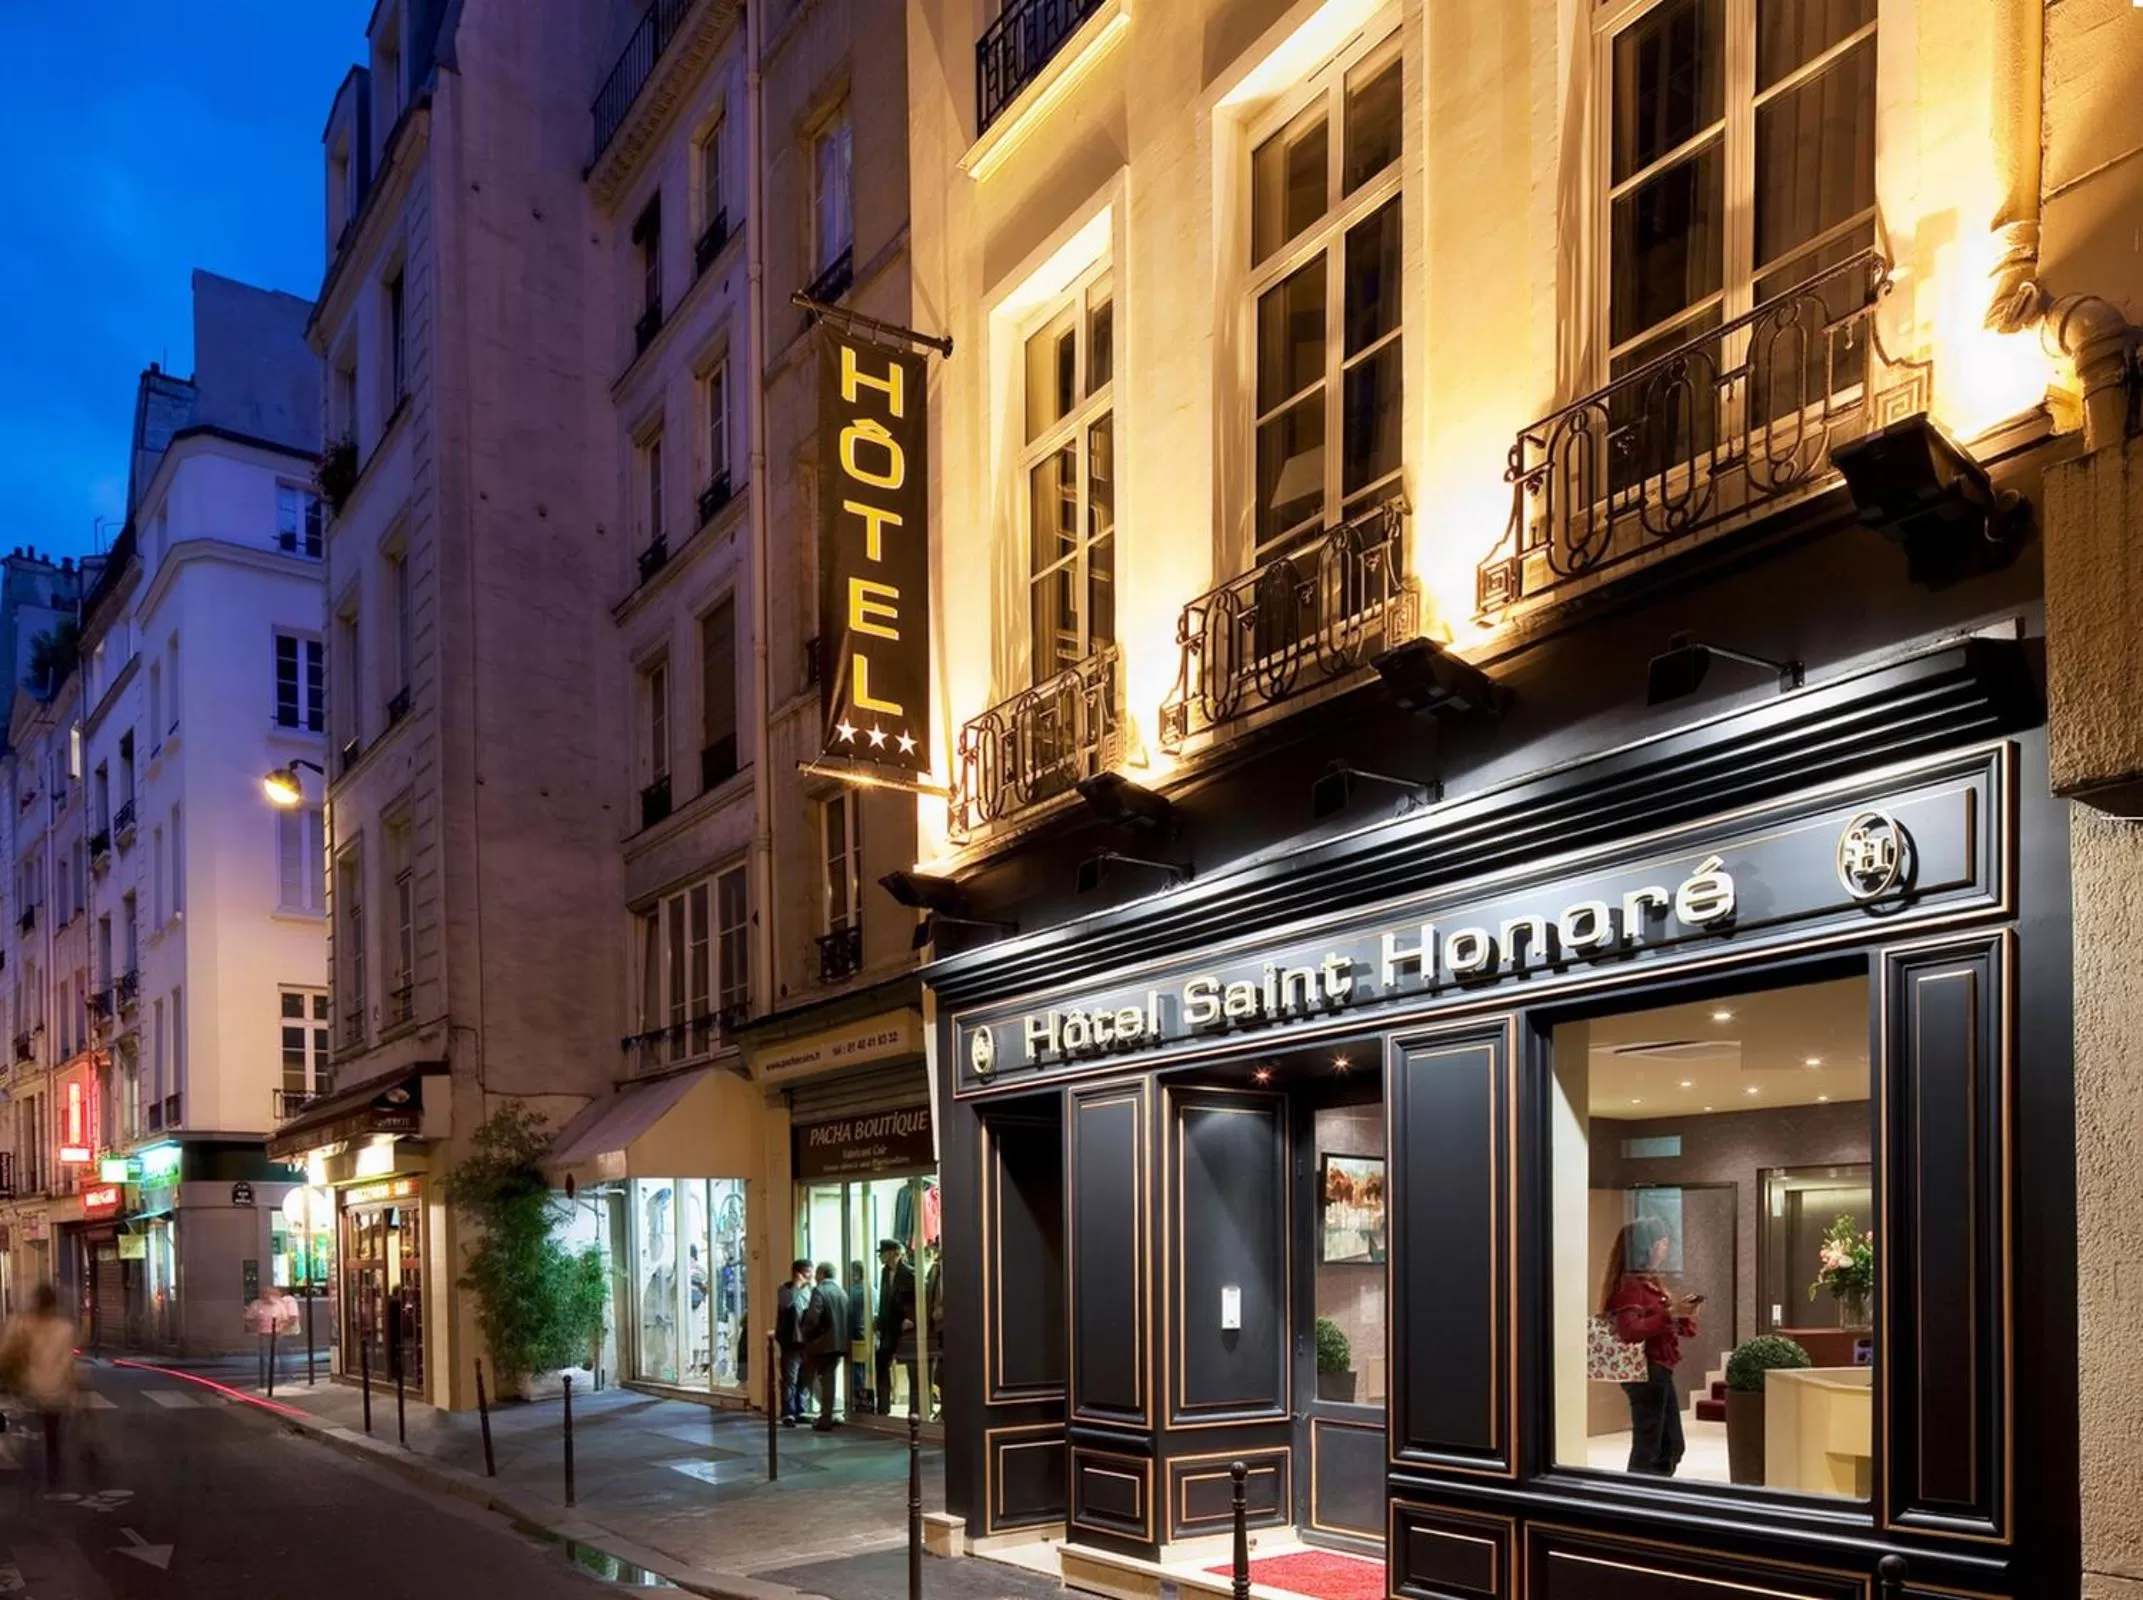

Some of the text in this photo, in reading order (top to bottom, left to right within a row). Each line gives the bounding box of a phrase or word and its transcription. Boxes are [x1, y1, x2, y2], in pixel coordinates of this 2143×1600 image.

[840, 345, 905, 717] HÔTEL
[1024, 855, 1735, 1059] Hôtel Saint Honoré
[810, 1123, 851, 1146] PACHA
